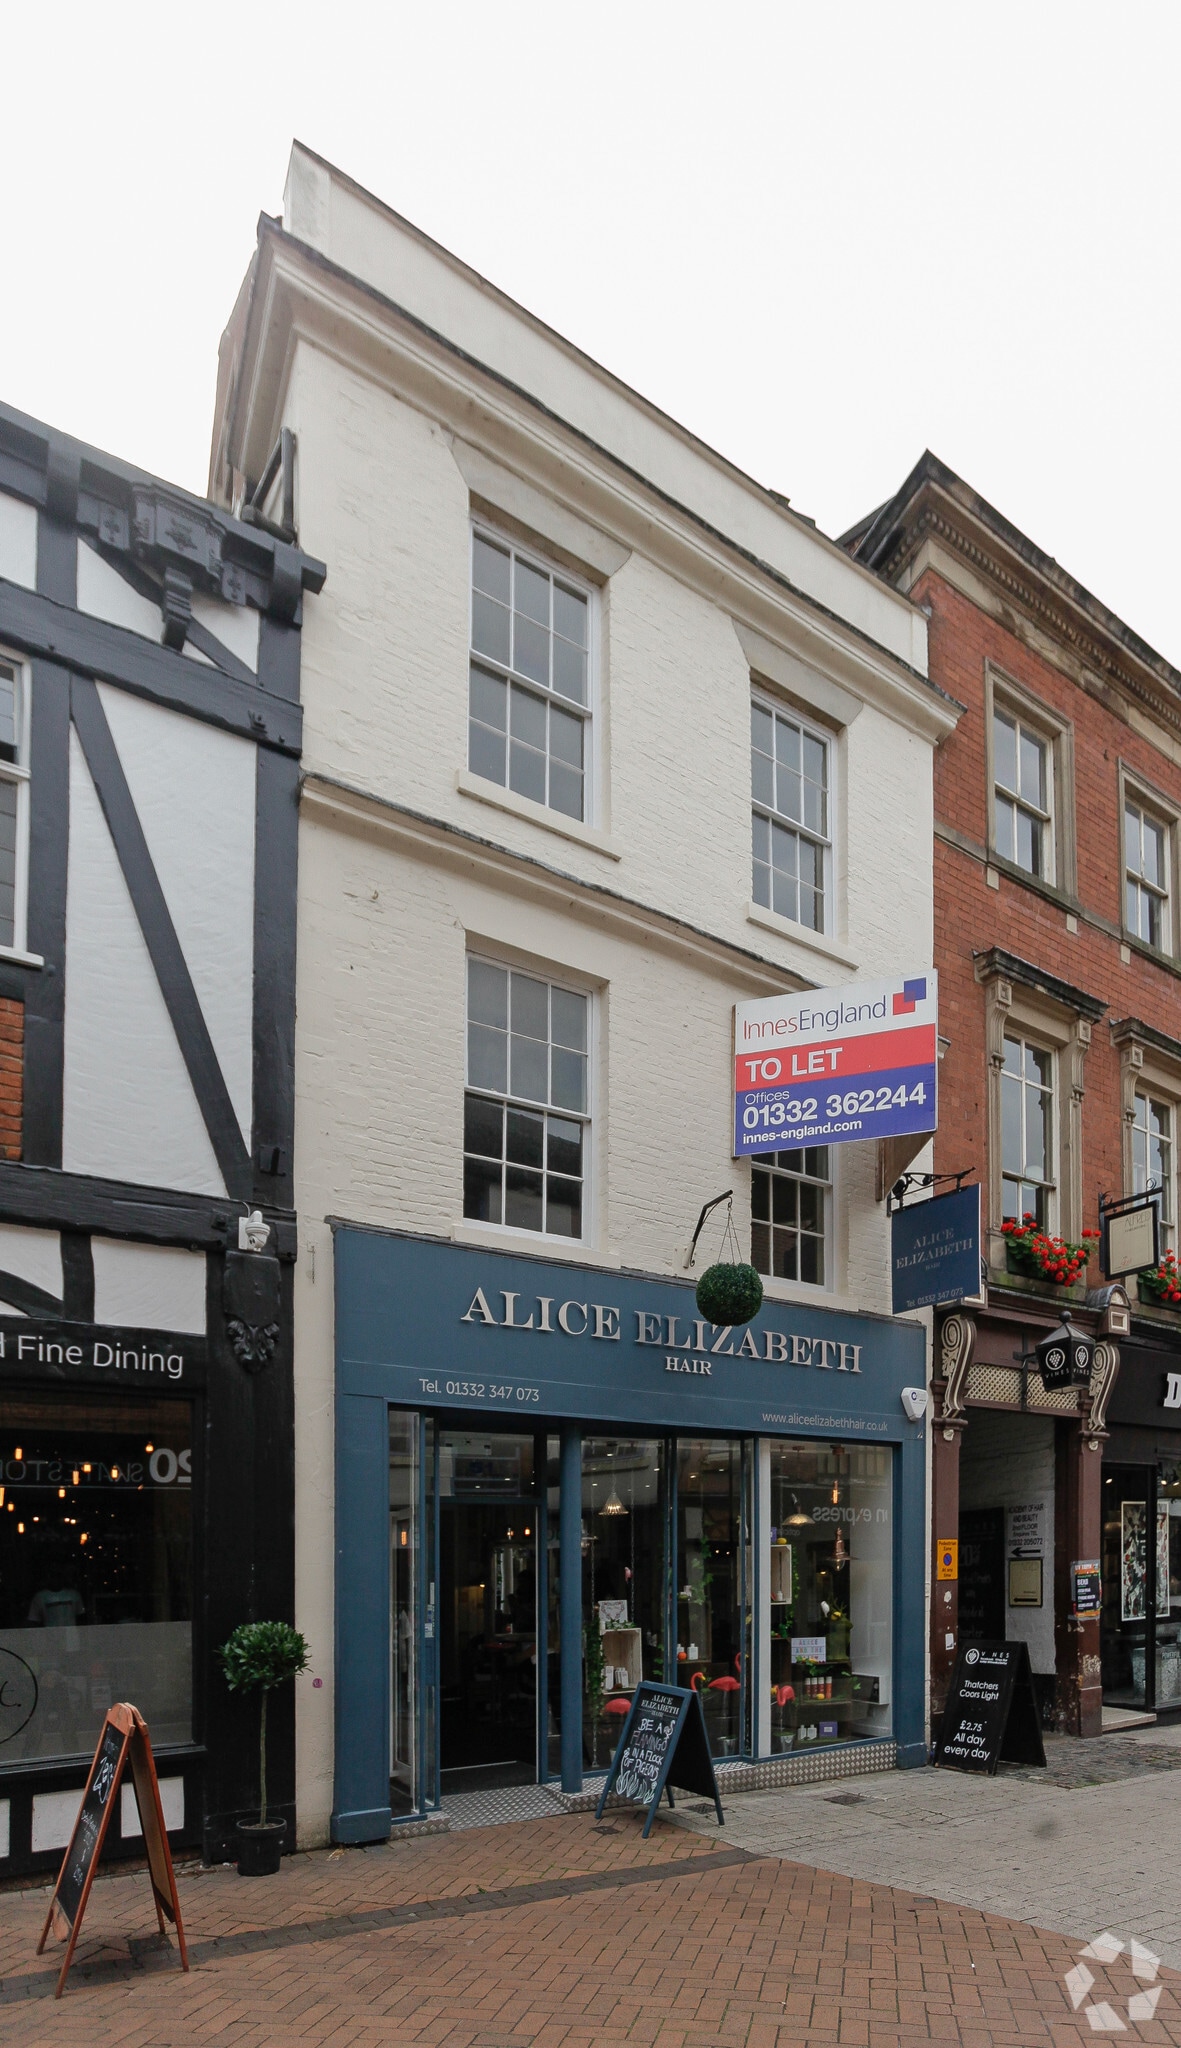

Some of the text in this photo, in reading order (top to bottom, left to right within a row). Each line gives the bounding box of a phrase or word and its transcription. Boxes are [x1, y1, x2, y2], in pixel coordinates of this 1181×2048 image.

[745, 1047, 843, 1082] TO LET
[743, 1082, 926, 1129] 01332 362244
[745, 1089, 790, 1105] Offices
[743, 1120, 862, 1144] innes-england.com
[913, 1228, 955, 1249] ALICE
[896, 1238, 973, 1269] ELIZABETH
[460, 1287, 863, 1374] ALICE ELIZABETH
[18, 1335, 83, 1365] Fine
[93, 1342, 184, 1379] Dining
[665, 1356, 713, 1375] HAIR
[419, 1378, 540, 1402] Tel. 01332 347 073
[762, 1412, 888, 1432] www.aliceelizabethhair.co.uk
[964, 1680, 999, 1690] Thatchers
[652, 1695, 673, 1705] ALICE
[960, 1689, 999, 1701] Coors Light
[641, 1700, 679, 1715] ELIZABETH
[638, 1718, 662, 1734] BE A
[960, 1720, 982, 1732] £2.75
[630, 1730, 667, 1751] FLAMINGO
[953, 1733, 986, 1747] All day
[645, 1750, 664, 1766] FLOCK
[944, 1745, 969, 1758] every
[971, 1749, 990, 1760] day
[633, 1759, 660, 1782] PIGEONS
